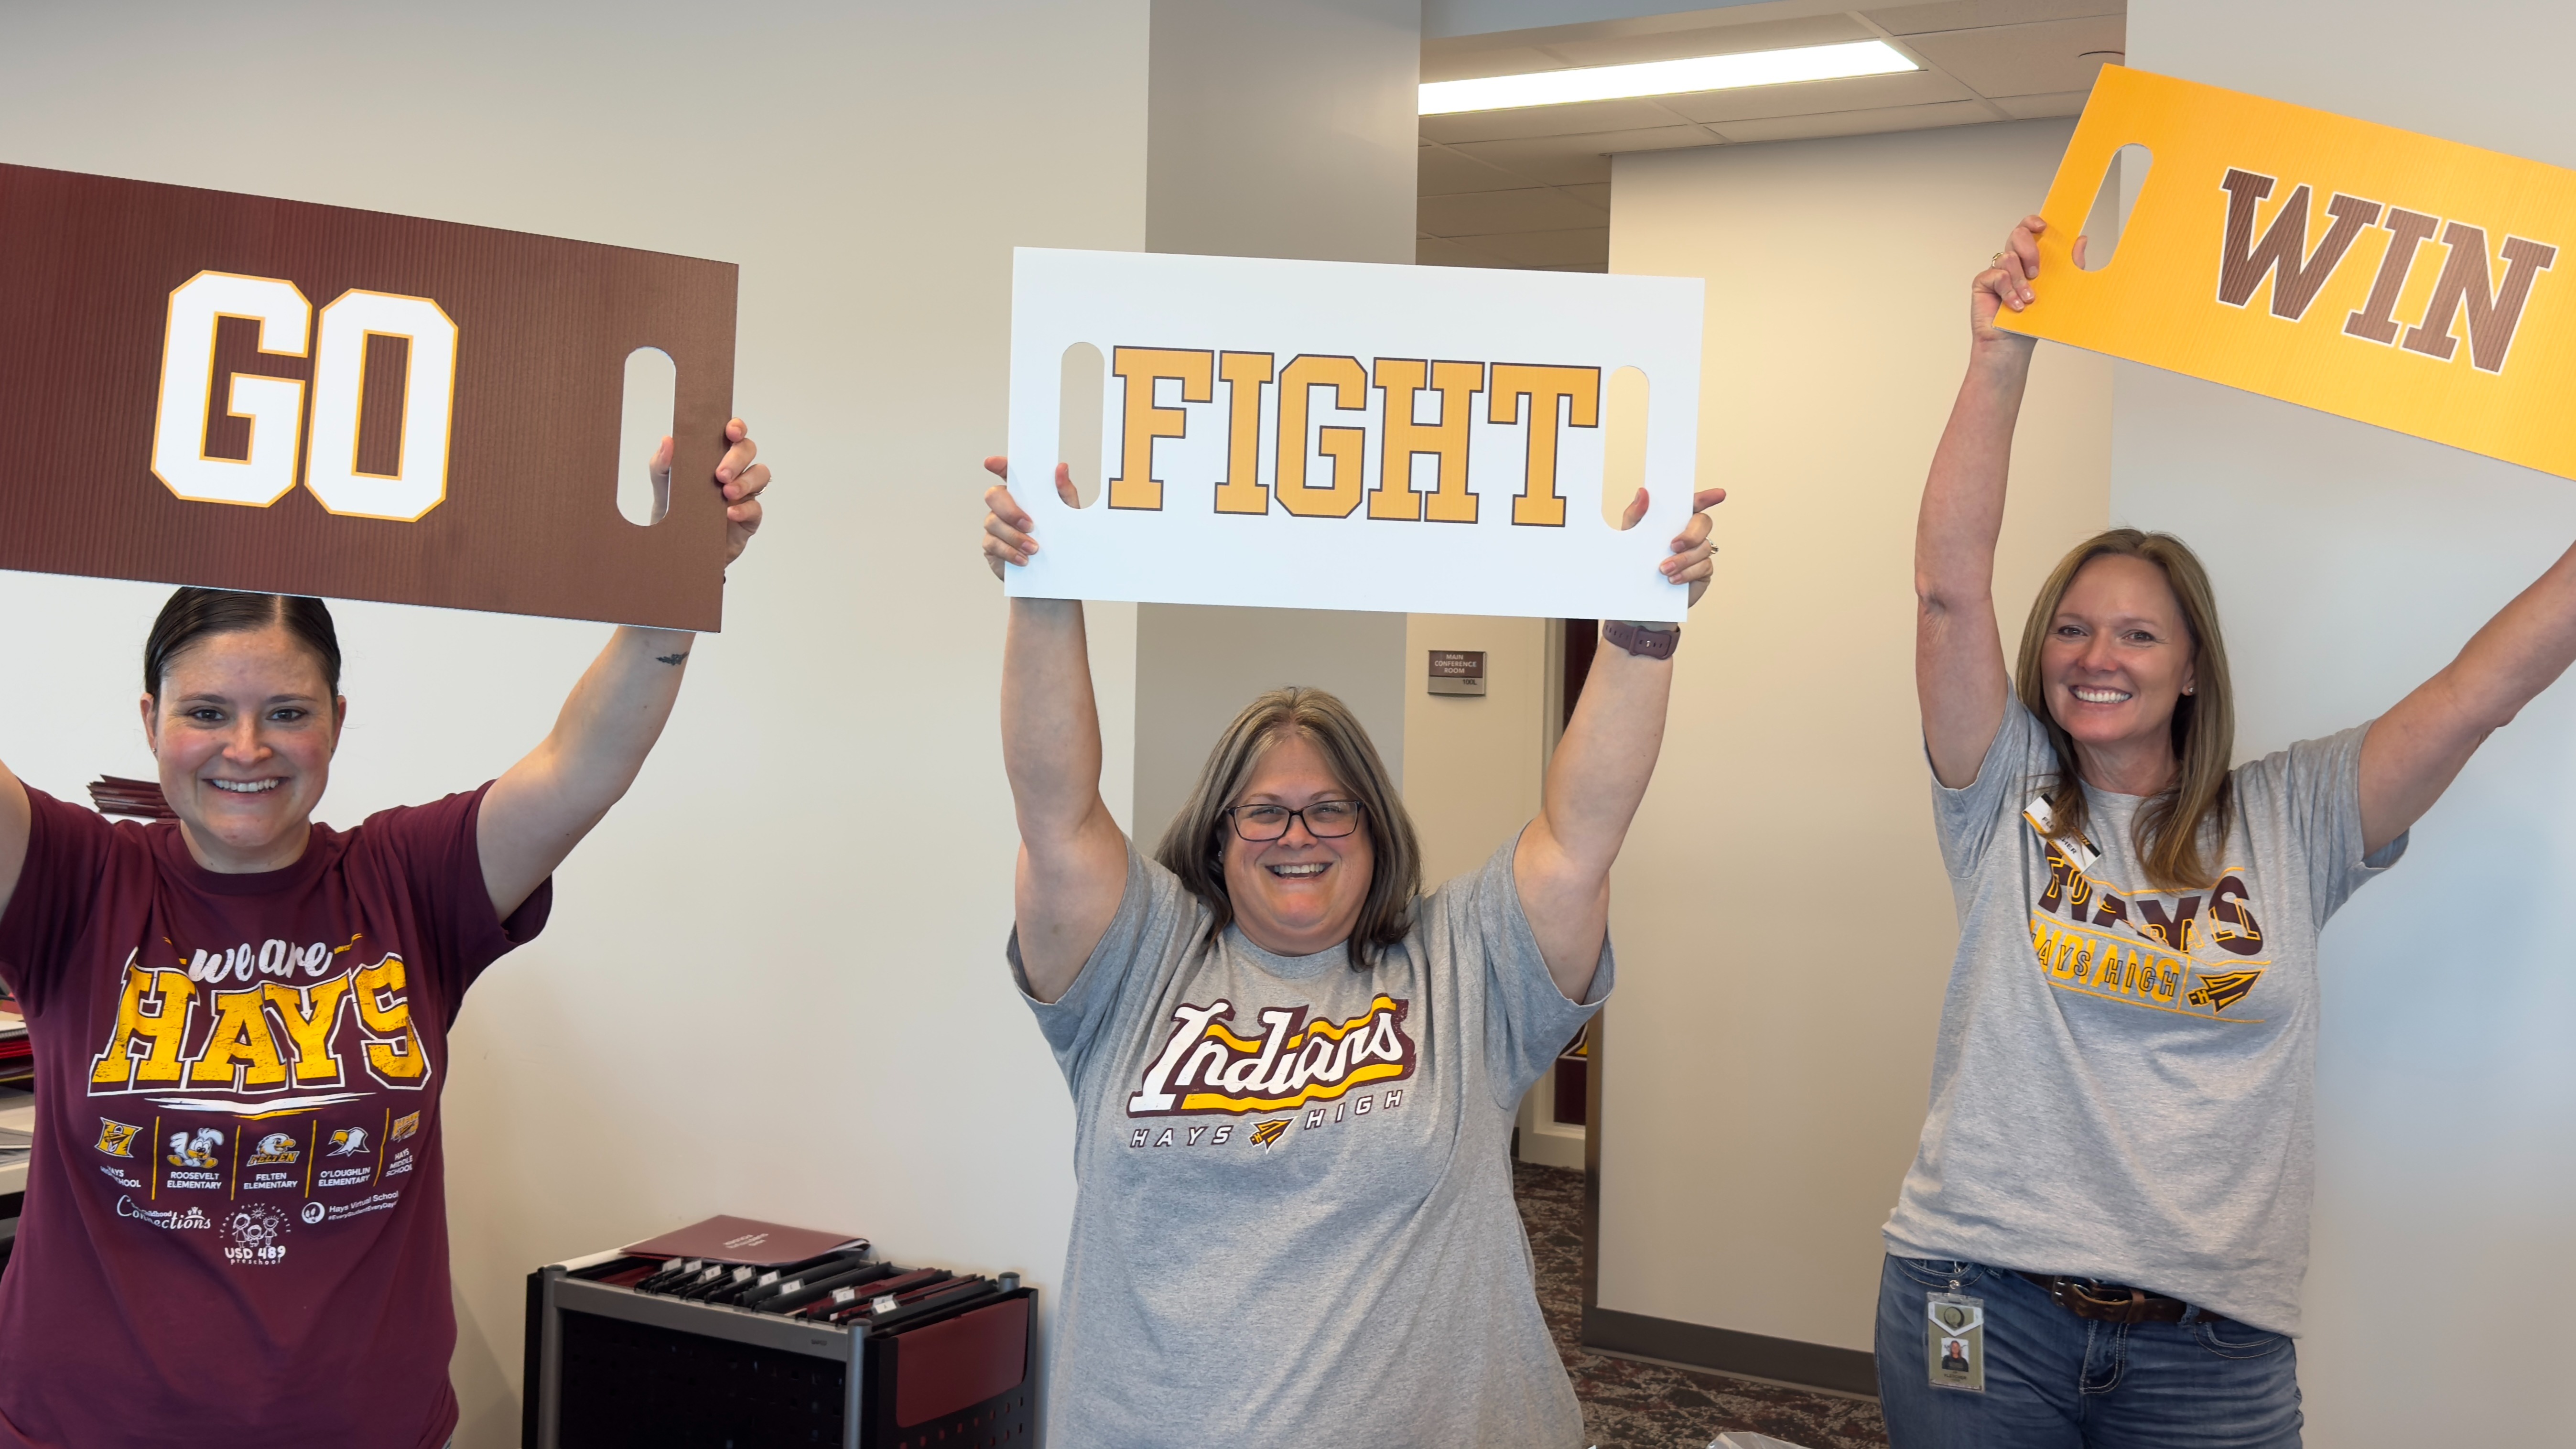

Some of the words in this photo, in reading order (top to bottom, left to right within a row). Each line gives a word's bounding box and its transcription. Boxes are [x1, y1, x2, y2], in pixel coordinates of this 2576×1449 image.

[2217, 166, 2559, 376] WIN
[151, 270, 458, 522] GO
[1108, 346, 1601, 527] FIGHT
[189, 943, 256, 983] we
[259, 939, 333, 978] are
[2104, 957, 2179, 997] HIGH
[87, 947, 432, 1096] HAYS
[1128, 998, 1407, 1115] Indians
[1129, 1125, 1234, 1148] HAYS
[1304, 1090, 1403, 1130] HIGH
[249, 1152, 297, 1165] FELTEN
[395, 1148, 410, 1160] HAYS
[390, 1155, 413, 1169] MIDDLE
[170, 1171, 219, 1180] ROOSEVELT
[256, 1173, 287, 1181] FELTEN
[320, 1167, 371, 1178] O'LOUGHLIN
[385, 1164, 413, 1177] SCHOOL
[167, 1180, 222, 1189] ELEMENTARY
[244, 1180, 298, 1189] ELEMENTARY
[318, 1175, 371, 1187] ELEMENTARY
[329, 1205, 349, 1213] Hays
[351, 1196, 371, 1209] Virtual
[373, 1190, 399, 1202] School
[225, 1247, 253, 1259] USD
[258, 1245, 286, 1259] 489
[230, 1257, 281, 1265] preschool
